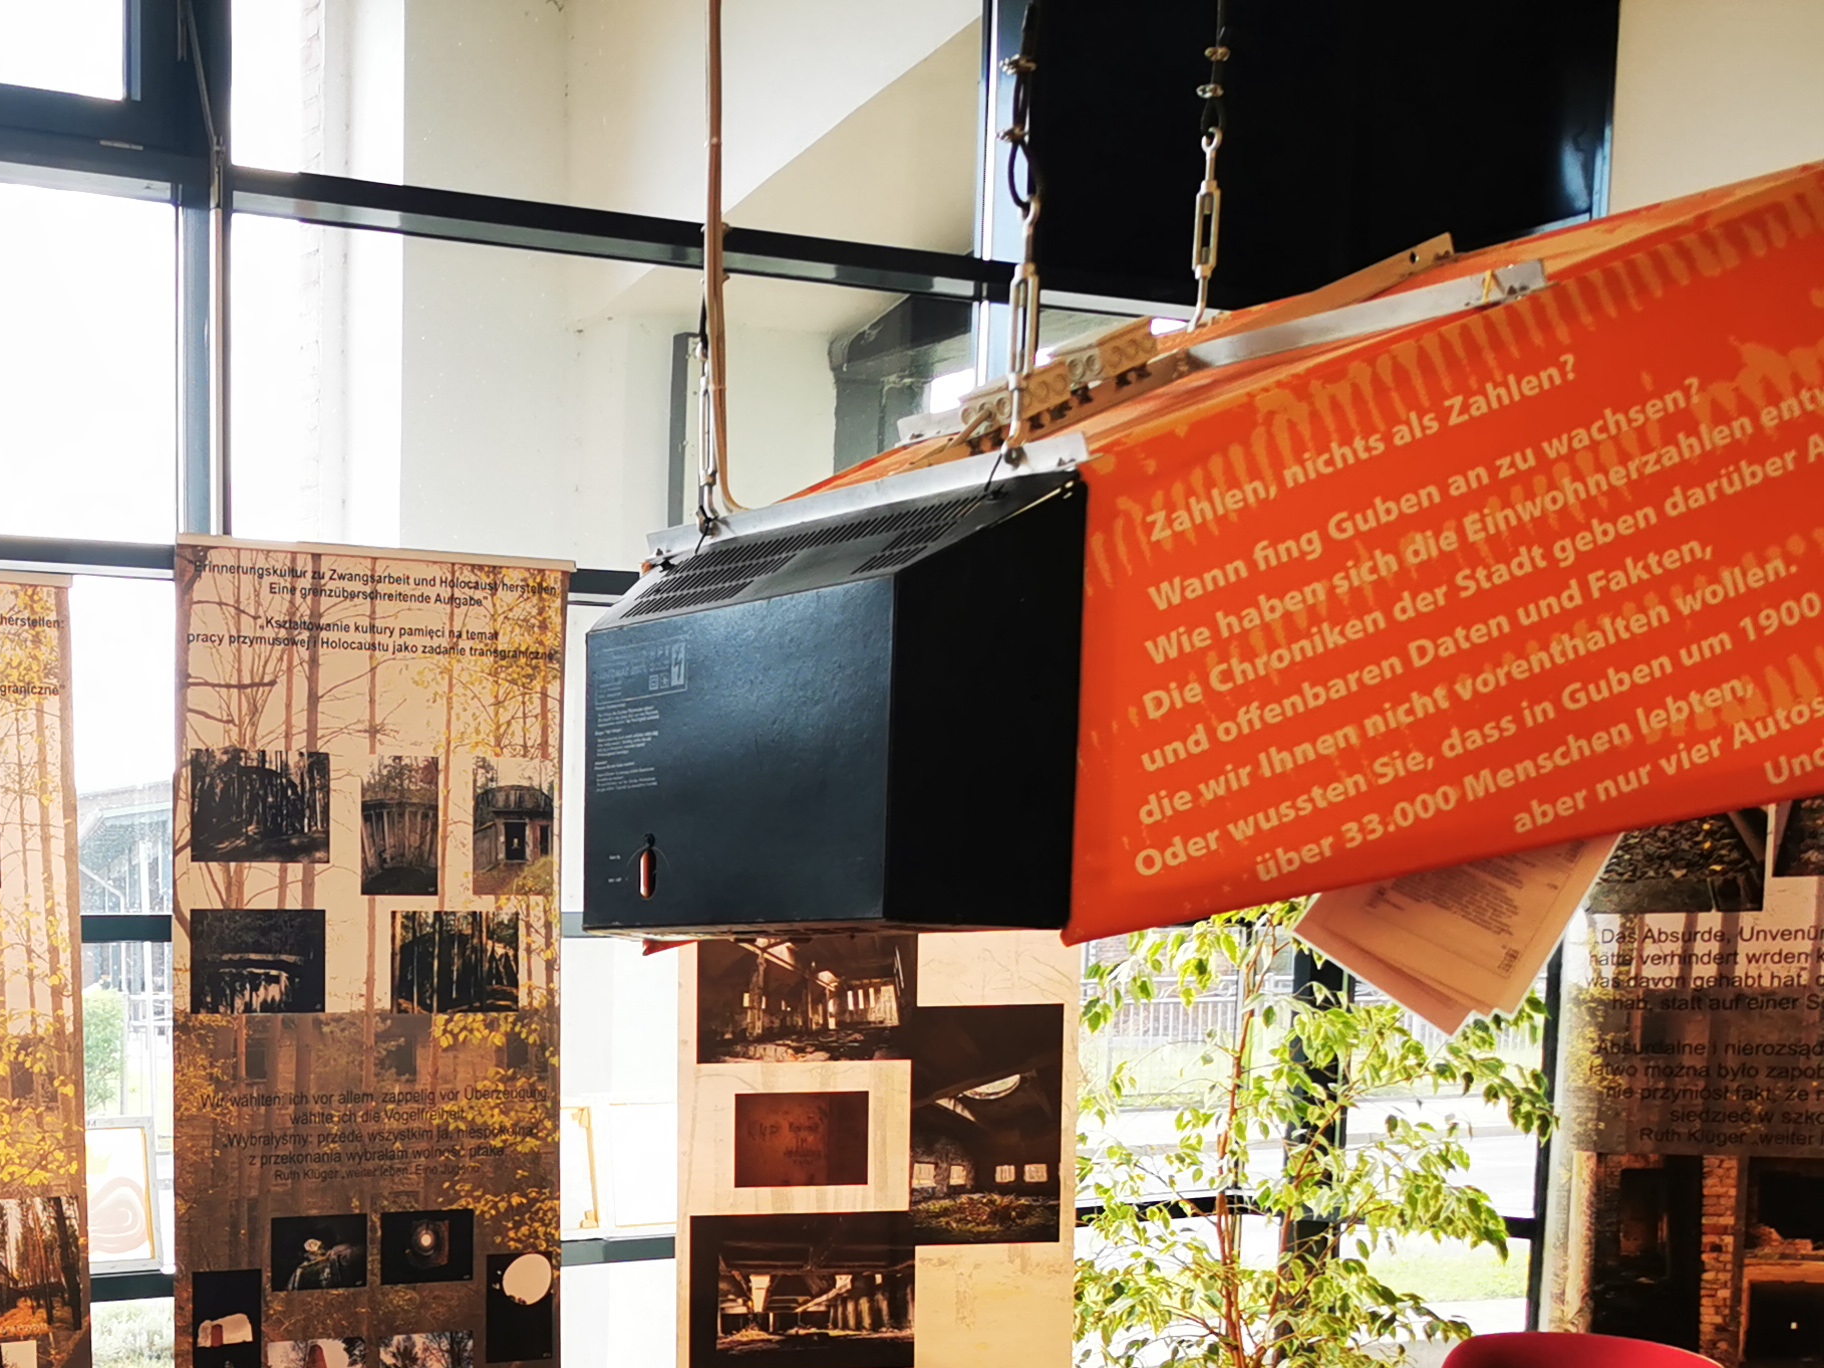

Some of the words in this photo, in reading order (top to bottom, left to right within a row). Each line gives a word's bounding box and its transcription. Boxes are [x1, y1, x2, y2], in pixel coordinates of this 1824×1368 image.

[1144, 625, 1213, 665] Wie
[1215, 580, 1326, 638] haben
[1332, 549, 1398, 594] sich
[1405, 529, 1458, 564] die
[1463, 414, 1753, 543] Einwohnerzahlen
[1146, 479, 1278, 542] Zahlen,
[1283, 432, 1386, 488] nichts
[1392, 411, 1439, 447] als
[1445, 353, 1575, 427] Zahlen?
[1147, 560, 1248, 612] Wann
[1253, 529, 1323, 571] fing
[1328, 485, 1441, 541] Guben
[1447, 465, 1489, 497] an
[1495, 447, 1536, 479] zu
[1542, 376, 1700, 461] wachsen?
[0, 613, 64, 628] herstellen:
[1139, 789, 1192, 825] die
[1199, 764, 1252, 801] wir
[1258, 724, 1358, 779] Ihnen
[1363, 684, 1451, 738] nicht
[1454, 604, 1671, 701] vorenthalten
[1675, 558, 1798, 616] wollen.
[1141, 724, 1210, 773] und
[1216, 656, 1403, 742] offenbaren
[1408, 613, 1510, 668] Daten
[1517, 579, 1582, 626] und
[1587, 539, 1713, 600] Fakten,
[1142, 681, 1203, 720] Die
[1209, 610, 1386, 692] Chroniken
[1393, 584, 1449, 622] der
[1454, 545, 1547, 598] Stadt
[1553, 505, 1657, 568] geben
[1664, 448, 1797, 518] darüber
[1135, 829, 1219, 876] Oder
[1227, 773, 1367, 842] wussten
[1373, 751, 1434, 785] Sie,
[1441, 714, 1517, 759] dass
[1521, 700, 1555, 728] in
[1561, 655, 1672, 711] Guben
[1679, 632, 1732, 666] um
[1739, 592, 1822, 641] 1900
[1255, 834, 1334, 882] über
[1341, 783, 1457, 849] 33.000
[1463, 722, 1632, 802] Menschen
[1636, 677, 1755, 736] lebten,
[1514, 788, 1587, 834] aber
[1595, 764, 1651, 802] nur
[1658, 736, 1723, 776] vier
[1640, 950, 1739, 966] verhindert
[1642, 927, 1731, 945] Absurde,
